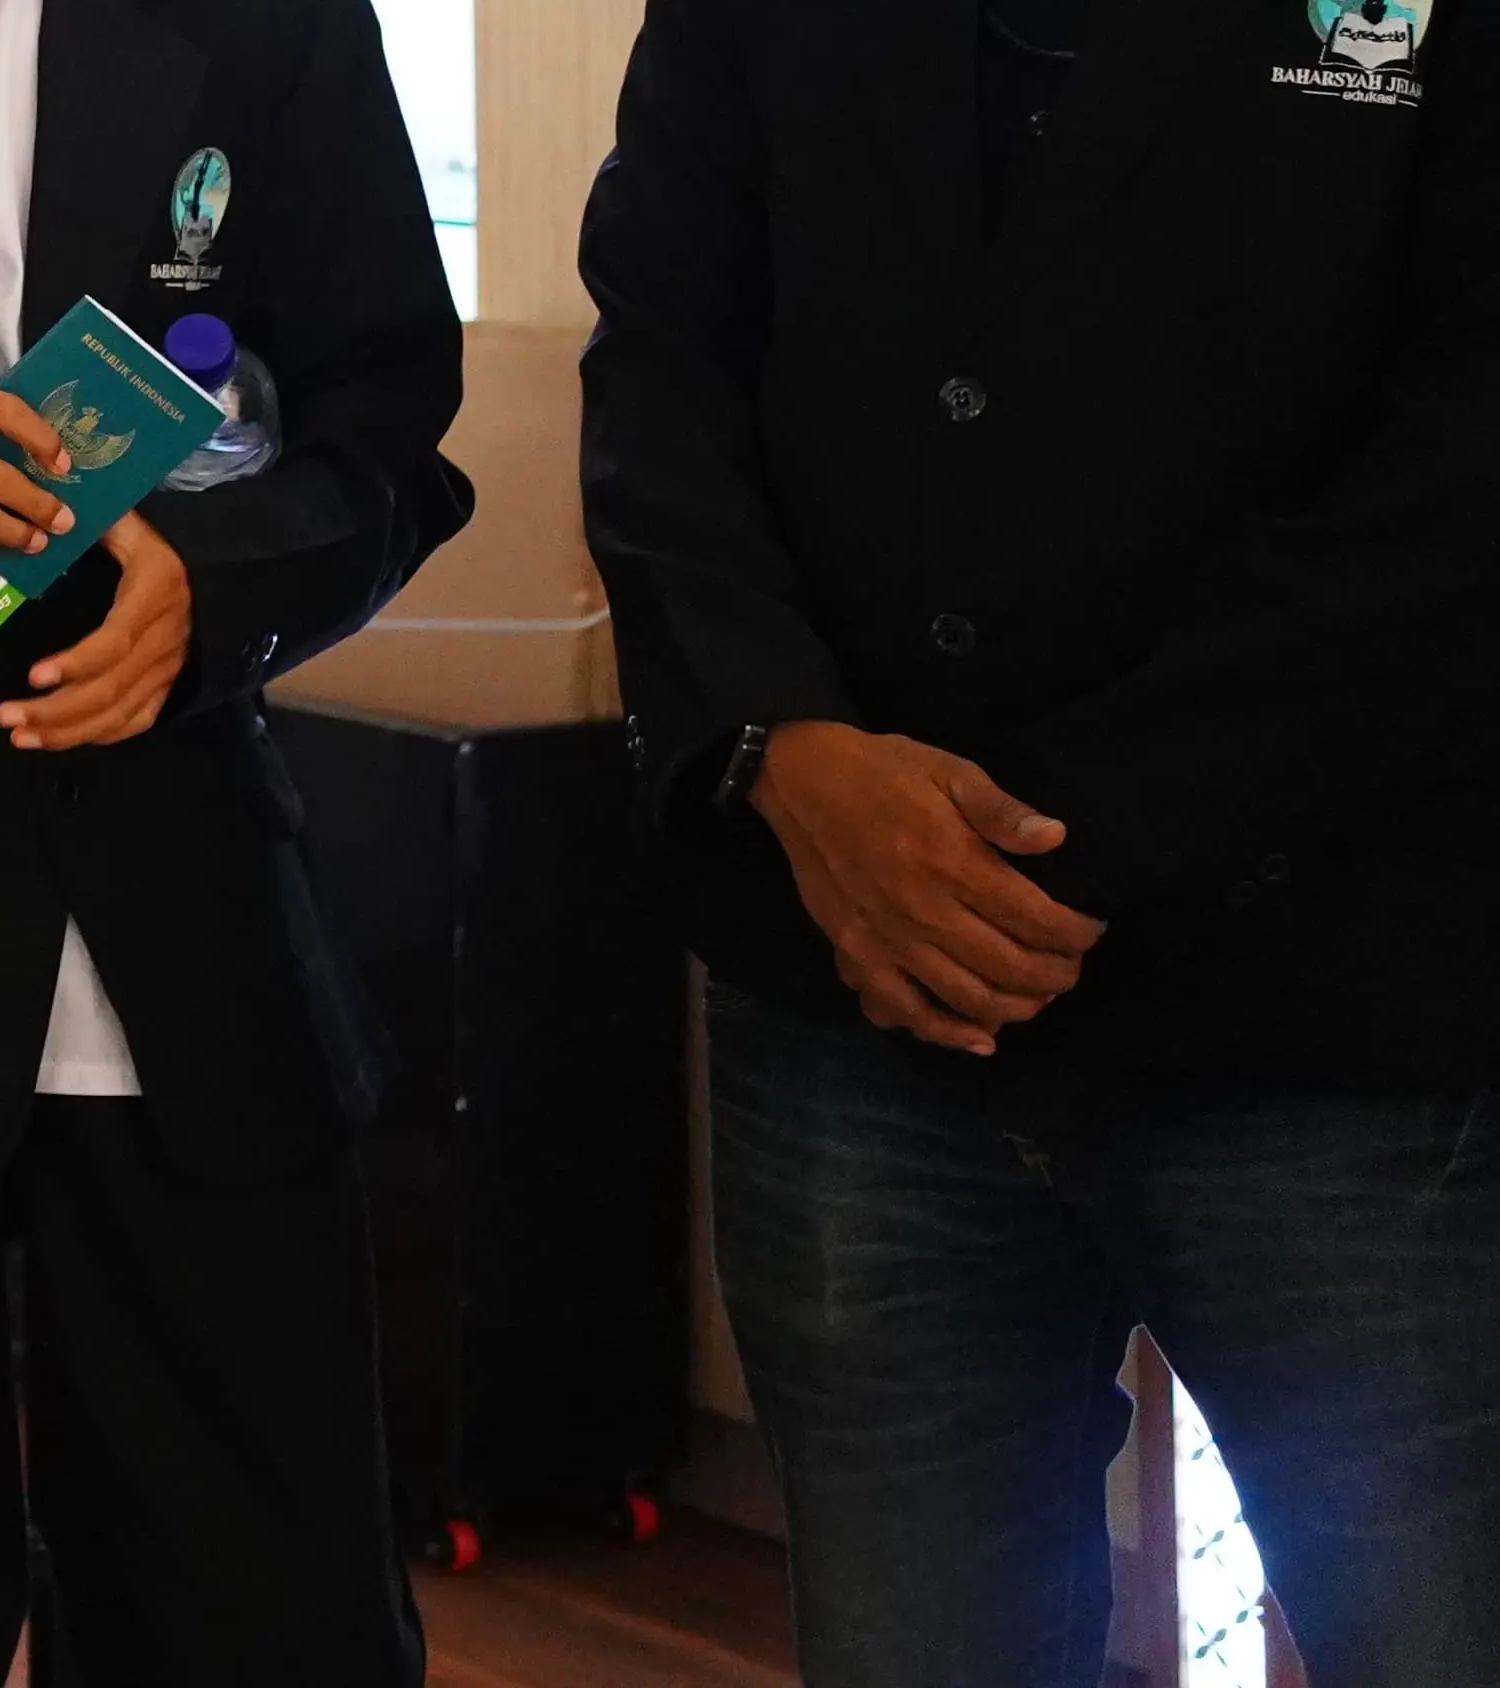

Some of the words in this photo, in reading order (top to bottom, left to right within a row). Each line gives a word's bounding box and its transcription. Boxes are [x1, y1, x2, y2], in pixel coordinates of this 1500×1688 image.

[1270, 67, 1382, 90] BAHARSYAH
[1342, 88, 1397, 105] edukasi
[81, 332, 131, 378] REPUBLIK
[129, 373, 186, 425] INDONESIA
